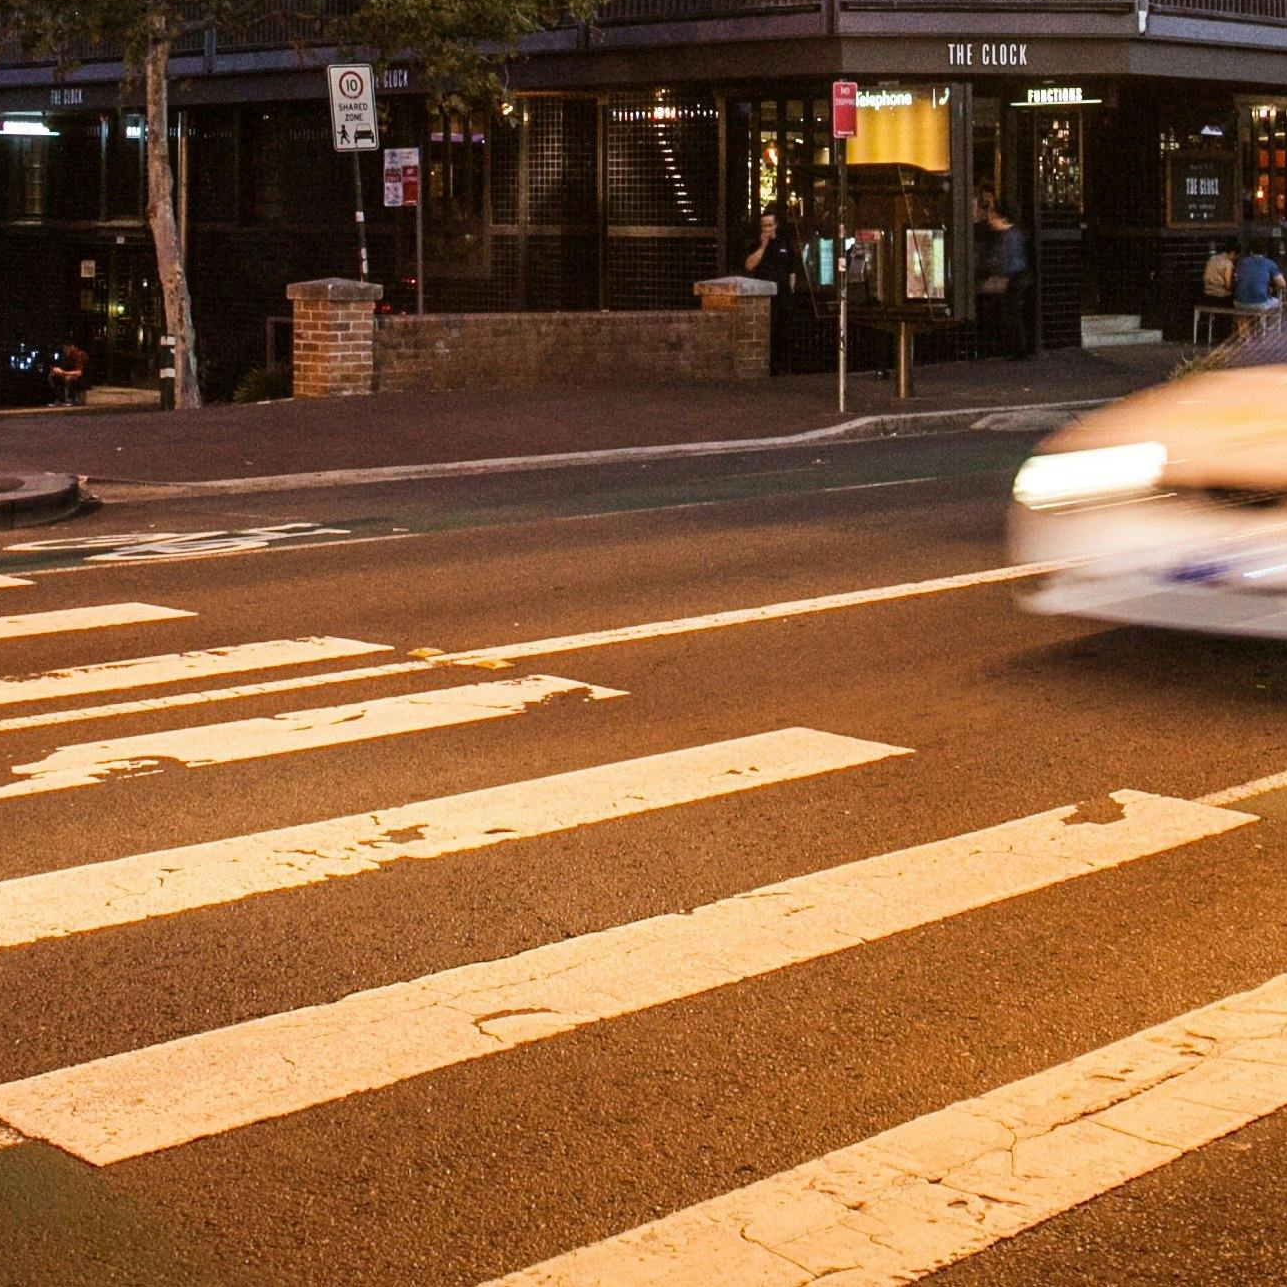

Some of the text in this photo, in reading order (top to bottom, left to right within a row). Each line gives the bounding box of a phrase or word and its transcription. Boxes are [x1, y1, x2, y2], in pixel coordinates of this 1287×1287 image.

[948, 44, 1028, 65] THE CLOCK
[345, 79, 358, 92] 10
[840, 86, 850, 95] NO
[856, 90, 913, 111] Telephone
[1027, 88, 1083, 103] FUNCTIONS
[338, 102, 368, 112] SHARED
[345, 114, 364, 122] ZONE
